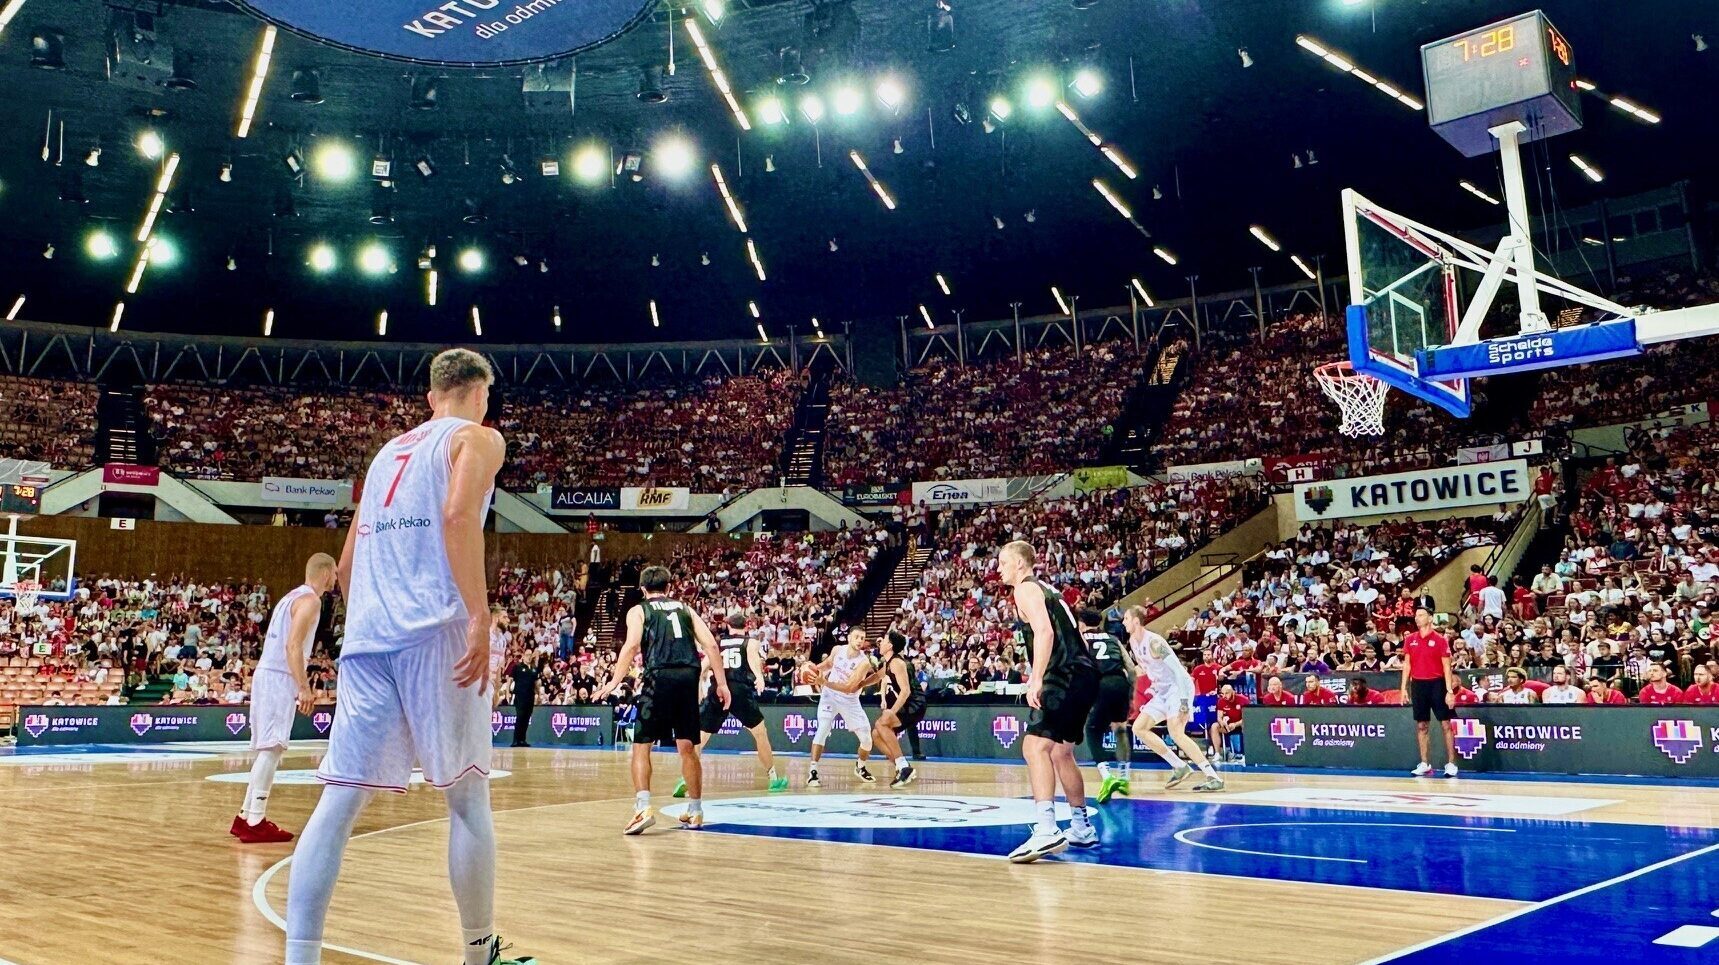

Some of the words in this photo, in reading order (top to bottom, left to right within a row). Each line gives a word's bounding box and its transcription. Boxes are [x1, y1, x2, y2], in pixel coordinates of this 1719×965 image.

[476, 21, 508, 39] dla
[1454, 26, 1514, 62] 7:28
[1489, 347, 1554, 365] Sports
[384, 452, 413, 507] 7
[1295, 469, 1305, 479] H
[286, 485, 307, 494] Bank
[309, 486, 336, 496] Pekao
[933, 490, 969, 500] Enea
[1351, 469, 1519, 508] KATOWICE
[640, 493, 671, 505] RMF
[118, 519, 127, 528] E
[375, 519, 397, 533] Bank
[399, 516, 431, 530] Pekao
[667, 612, 683, 639] 1
[38, 644, 47, 653] E
[1092, 641, 1111, 660] 2
[720, 648, 742, 669] 15
[52, 717, 99, 726] KATOWICE
[1311, 724, 1386, 738] KATOWICE
[1493, 725, 1582, 740] KATOWICE
[1510, 741, 1545, 752] odmiany
